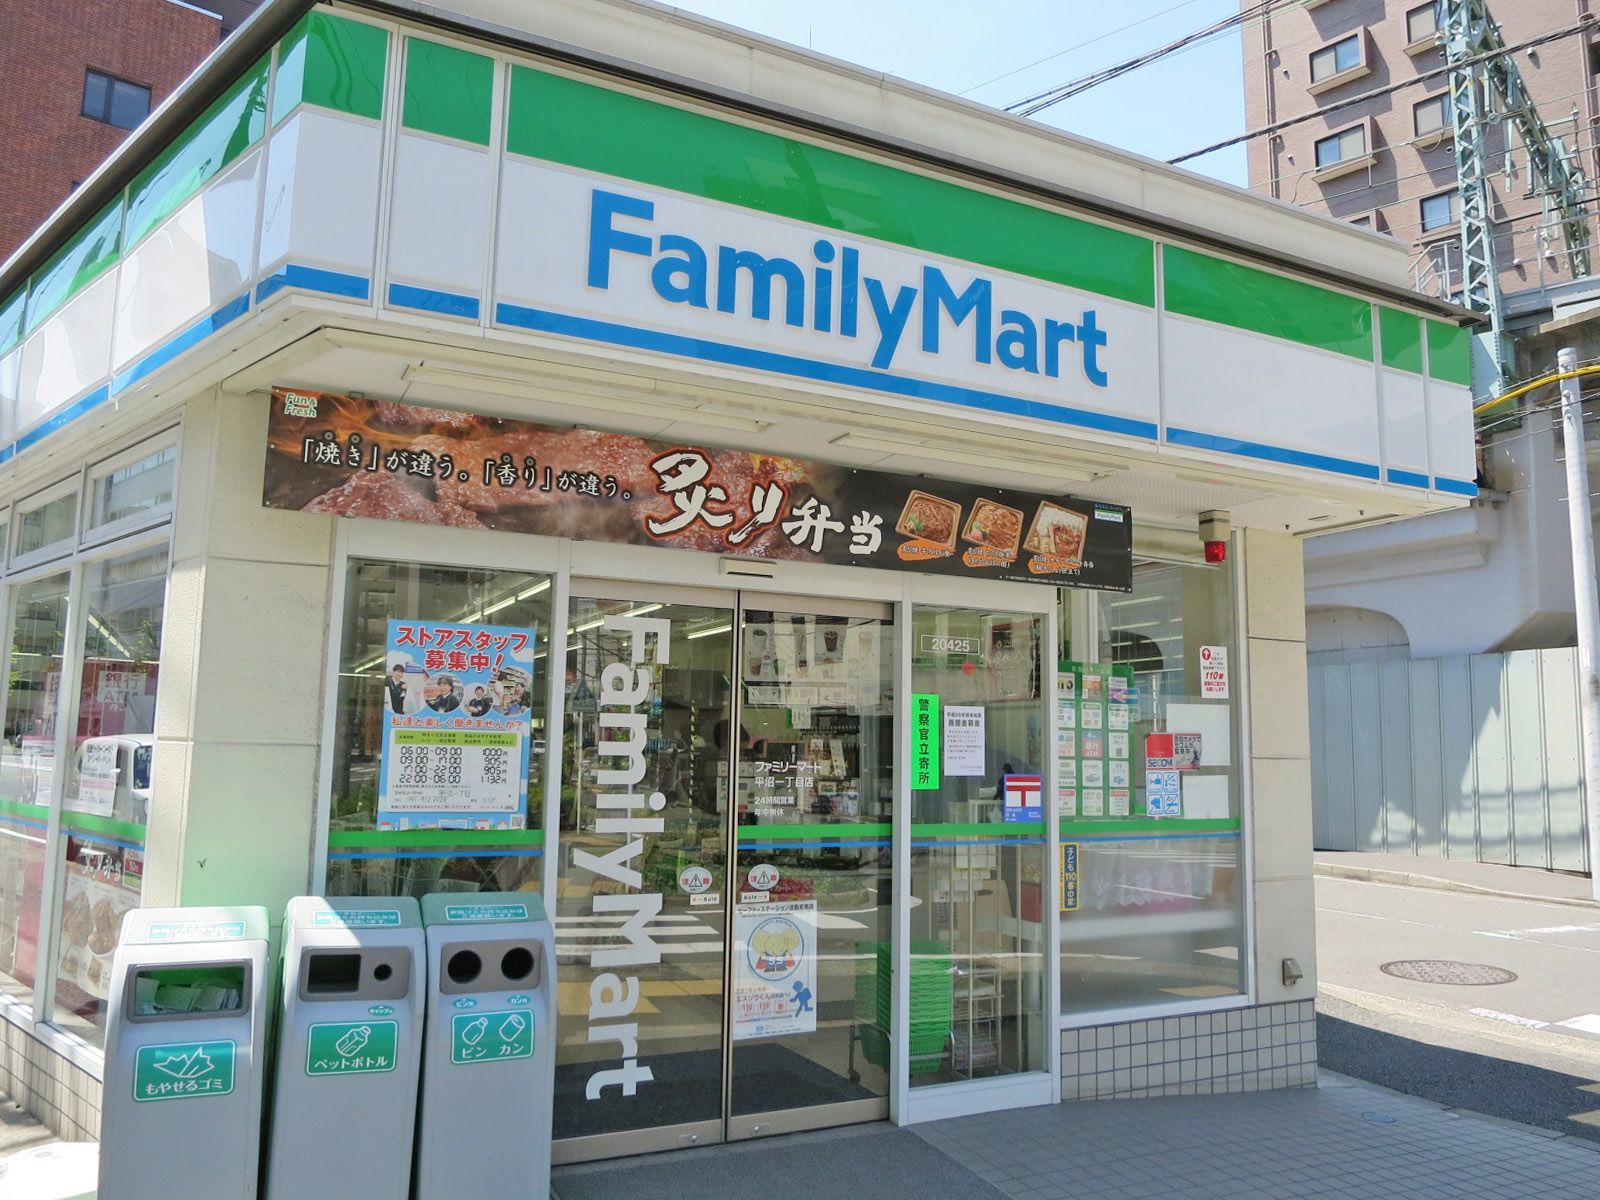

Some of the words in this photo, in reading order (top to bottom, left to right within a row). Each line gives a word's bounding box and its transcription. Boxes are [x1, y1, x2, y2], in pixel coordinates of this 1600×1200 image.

[587, 188, 1108, 388] FamilyMart
[284, 404, 317, 418] Fresh
[396, 626, 529, 652] ストアスタッフ
[932, 638, 970, 651] 20425
[918, 698, 929, 785] 警察官立寄所
[754, 761, 822, 773] ファミリーマート
[1147, 758, 1173, 768] SECOM
[754, 776, 814, 787] 平沼一丁目店
[573, 614, 671, 1100] FamilyMart
[462, 1046, 488, 1059] ビン
[499, 1043, 524, 1056] カン
[315, 1055, 389, 1070] ペットボトル
[146, 1078, 223, 1095] もやせるゴミ
